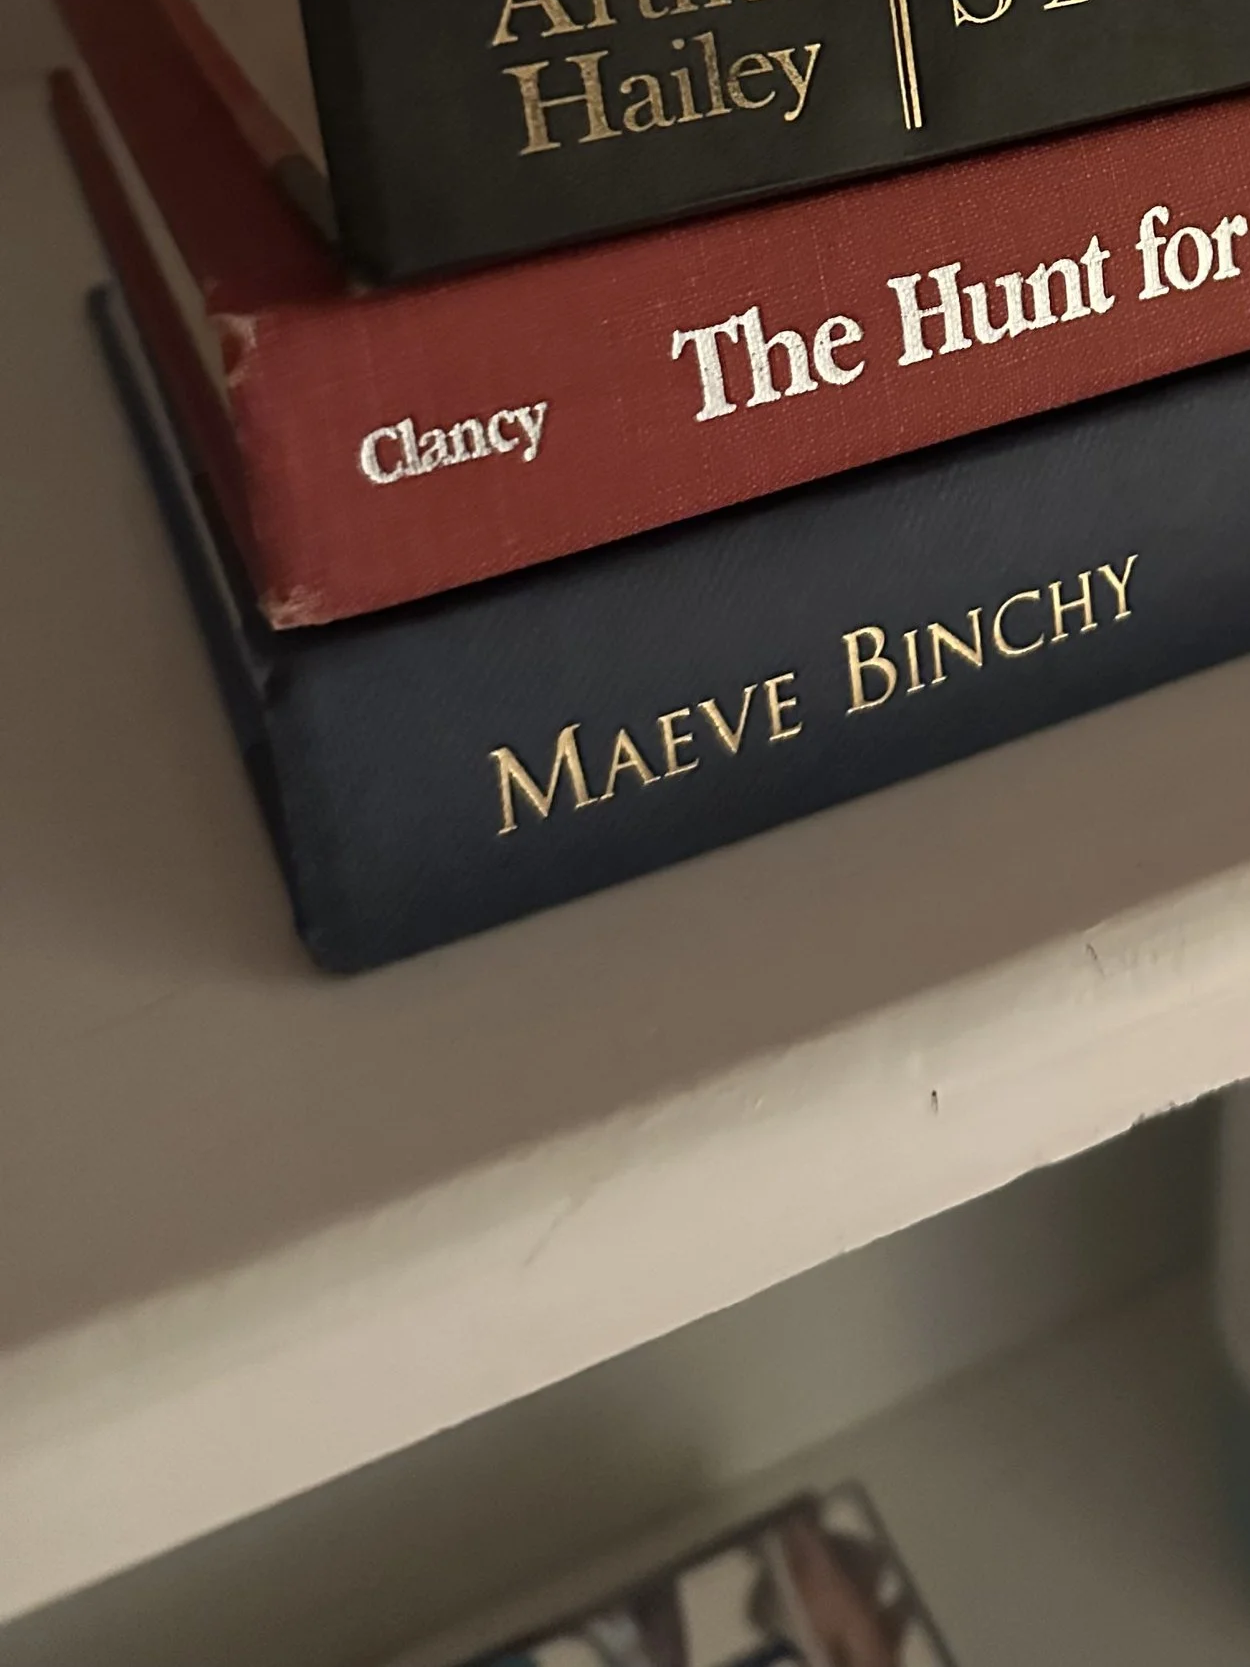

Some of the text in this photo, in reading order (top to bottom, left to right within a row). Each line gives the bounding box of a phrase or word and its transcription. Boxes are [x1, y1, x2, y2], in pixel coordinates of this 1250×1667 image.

[502, 32, 821, 156] Hailey
[671, 306, 864, 423] The
[887, 234, 1115, 368] Hunt
[1136, 204, 1248, 301] for
[359, 400, 548, 486] Clancy
[489, 554, 1138, 836] MAEVE BINCHY
